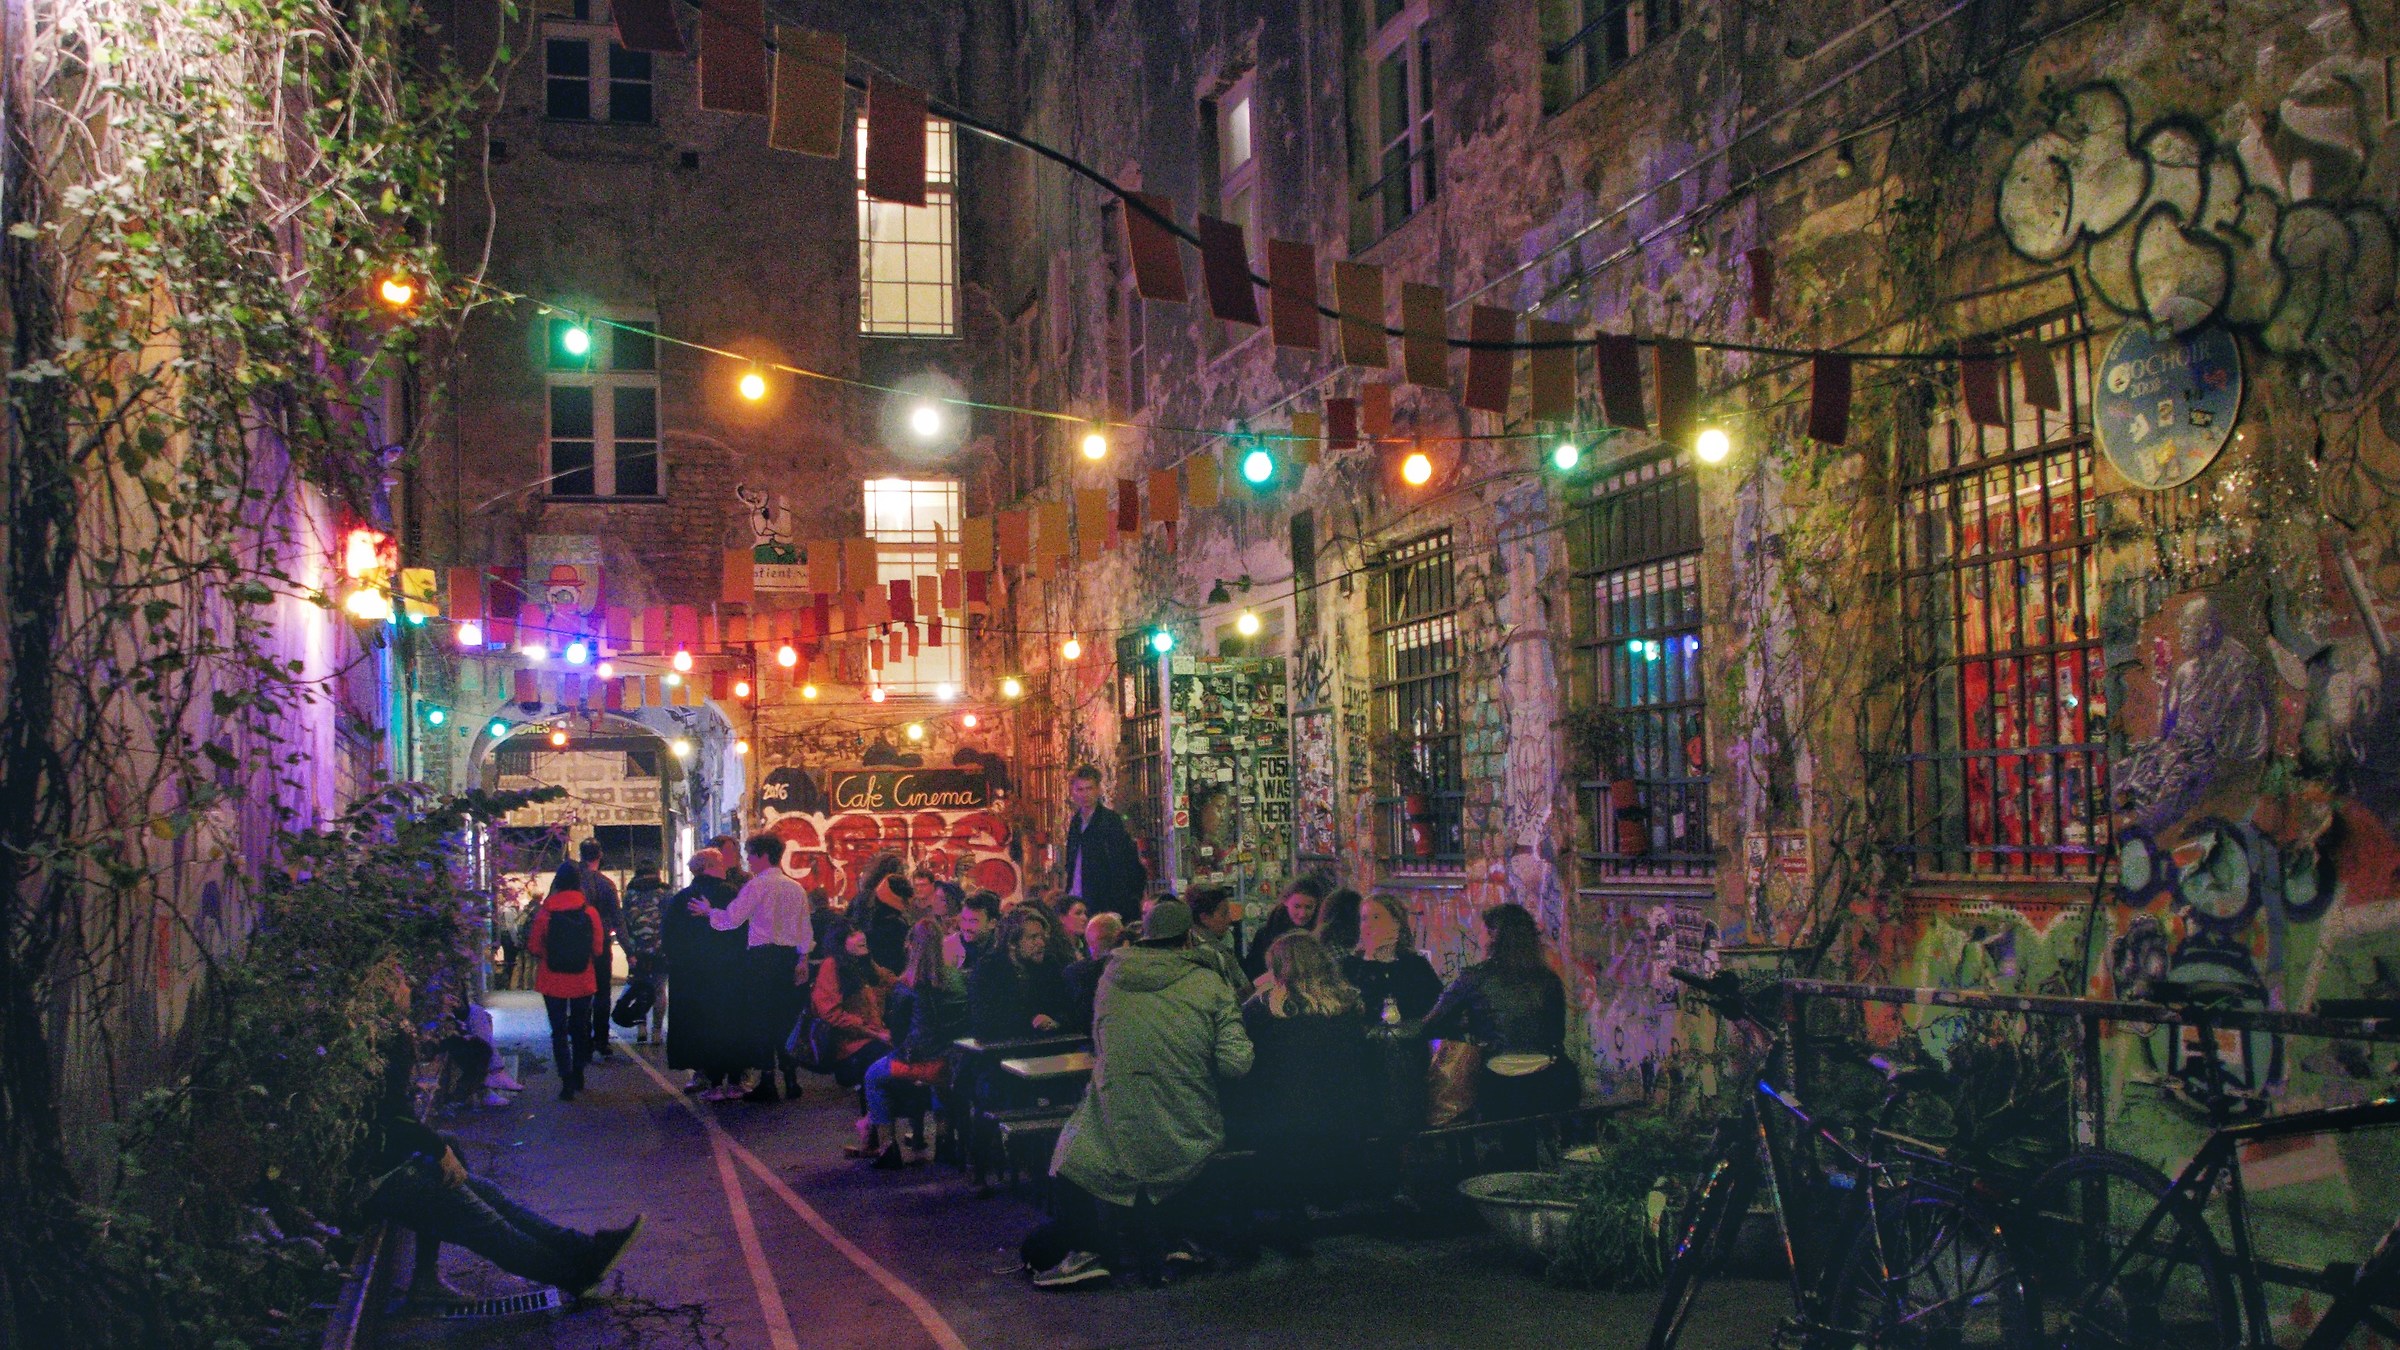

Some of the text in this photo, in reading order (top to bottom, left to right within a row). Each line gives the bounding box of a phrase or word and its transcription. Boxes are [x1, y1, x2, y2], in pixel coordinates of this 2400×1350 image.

[836, 774, 982, 811] Café Cinema
[1262, 779, 1291, 799] WAS
